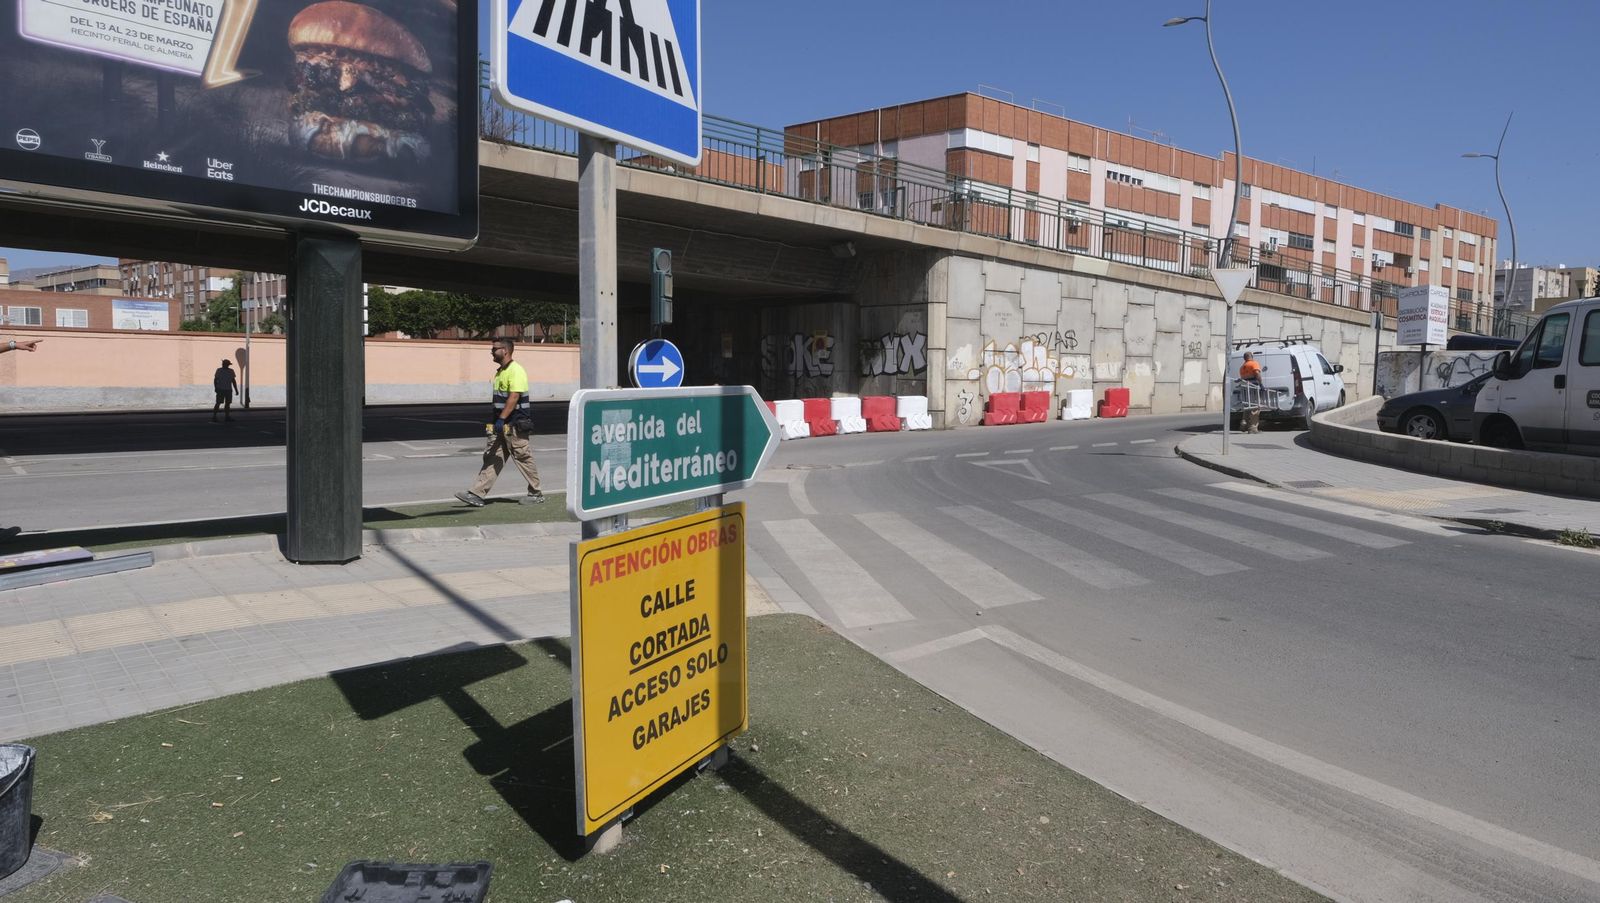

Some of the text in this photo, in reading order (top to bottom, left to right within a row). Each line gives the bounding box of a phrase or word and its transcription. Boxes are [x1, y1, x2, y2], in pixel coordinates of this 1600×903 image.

[70, 16, 194, 51] DEL 13 AL 23 DE MARZO
[141, 4, 159, 20] DE
[164, 10, 213, 33] ESPAÑA
[71, 27, 111, 42] RECINTO
[112, 36, 142, 49] FERIAL
[143, 43, 156, 53] DE
[17, 135, 40, 144] PEPSI
[143, 160, 183, 173] Heineken
[207, 157, 233, 170] Uber
[207, 168, 234, 181] Eats
[299, 198, 372, 220] JCDecaux
[312, 183, 417, 208] THECHAMPIONSBURGER.ES
[591, 409, 702, 445] avenida del
[589, 445, 737, 496] Mediterráneo
[589, 523, 737, 587] ATENCIÓN OBRAS
[640, 579, 695, 618] CALLE
[629, 613, 710, 666] CORTADA
[608, 642, 728, 722] ACCESO SOLO
[632, 688, 711, 751] GARAJES
